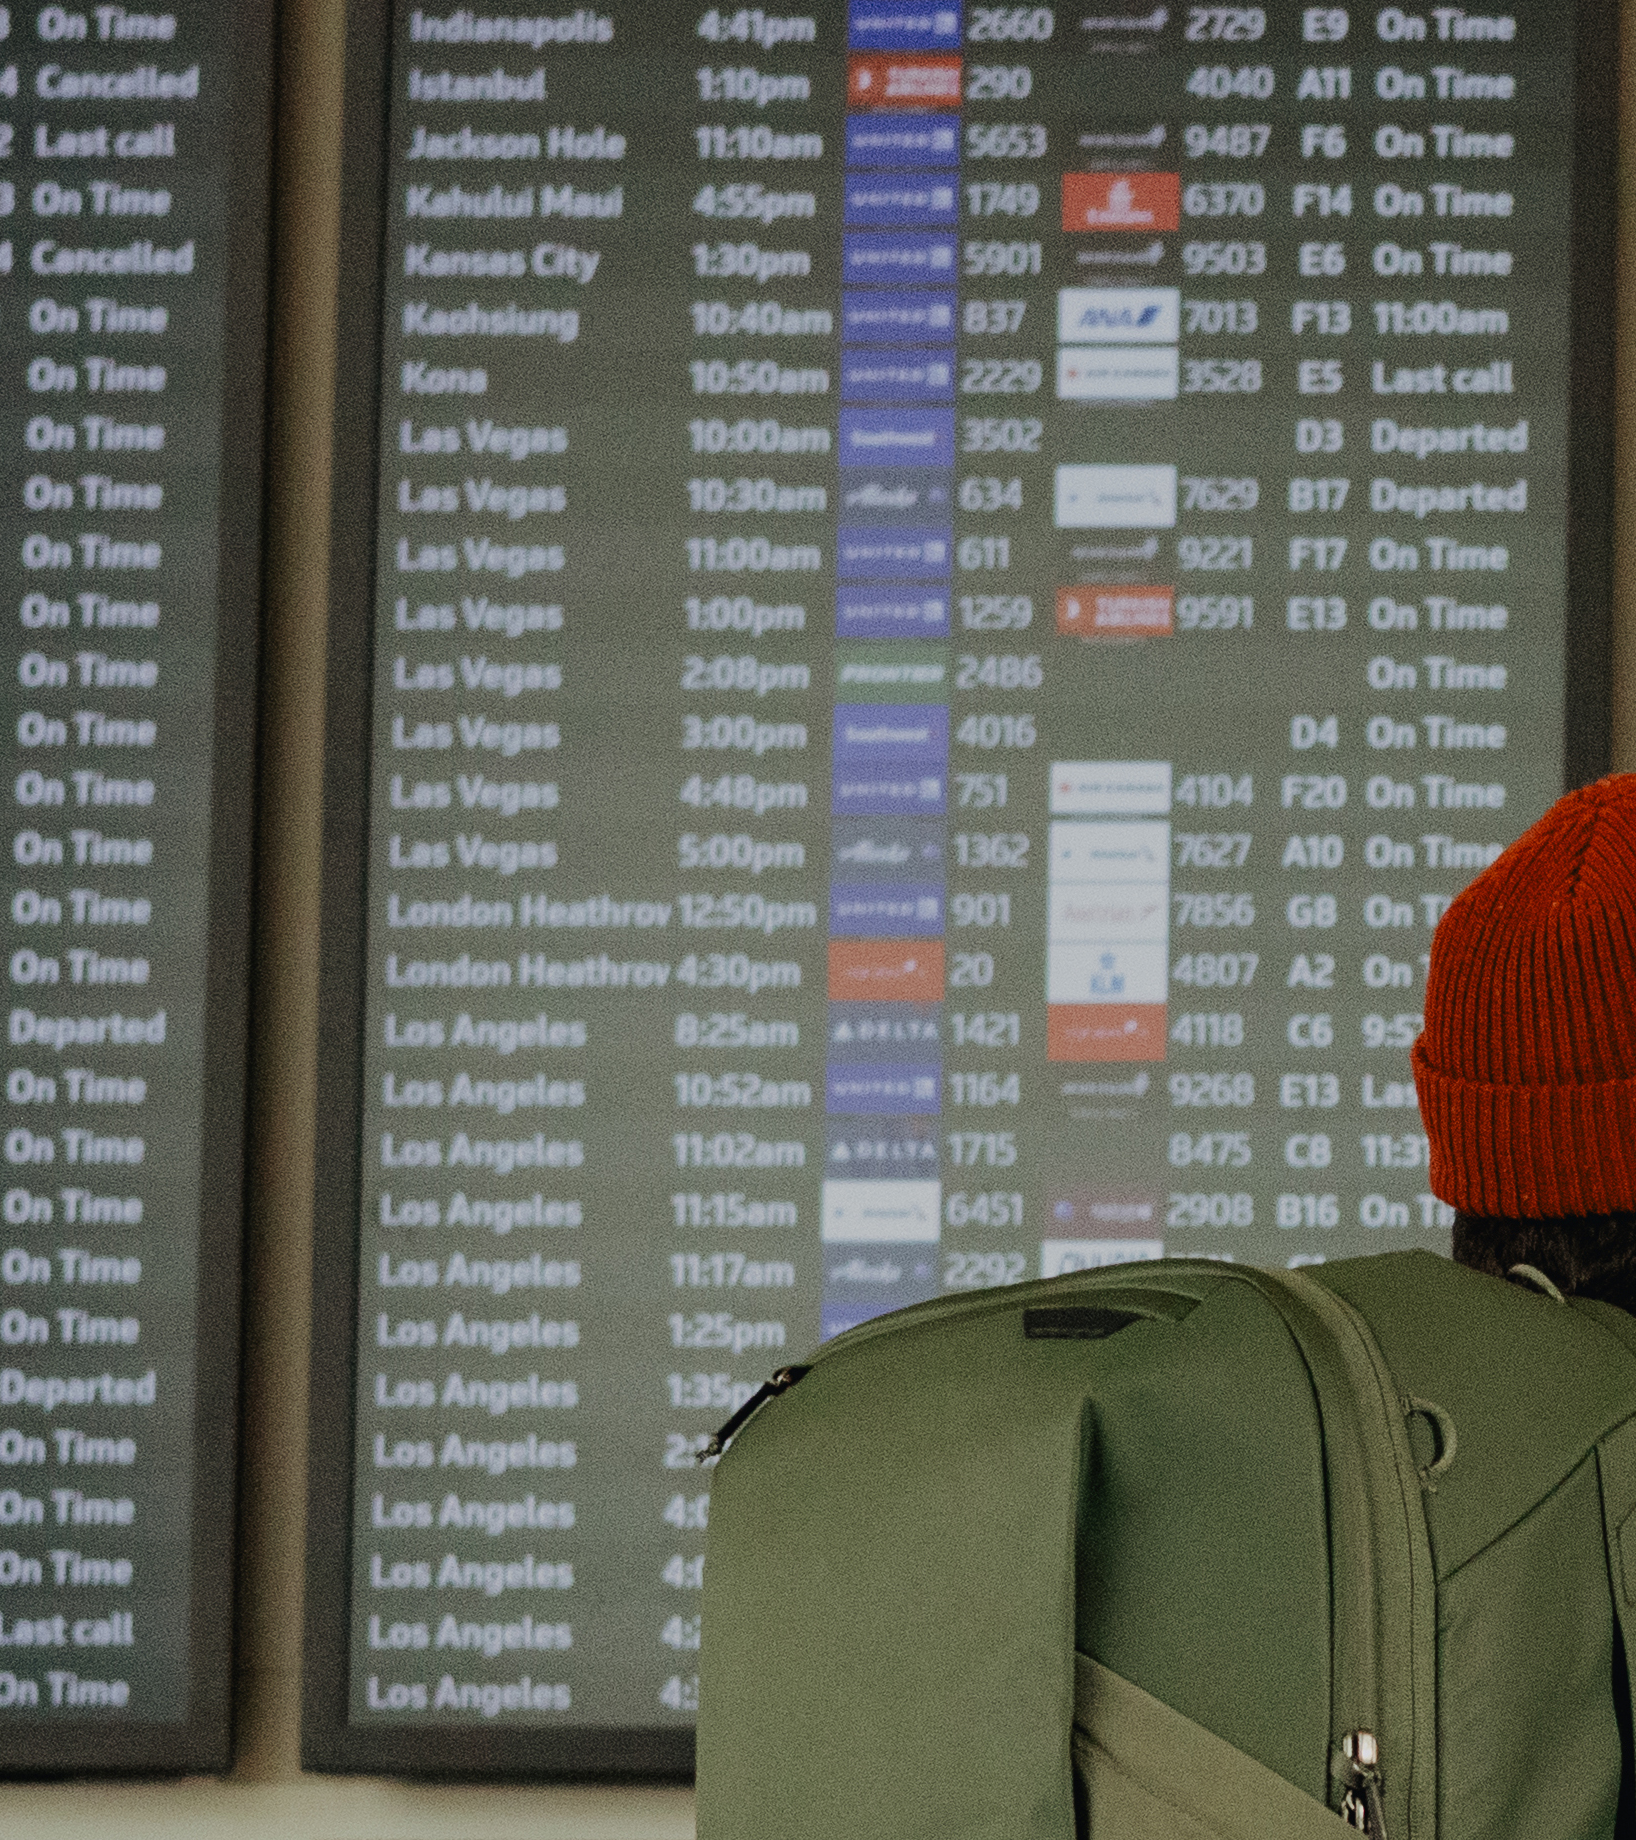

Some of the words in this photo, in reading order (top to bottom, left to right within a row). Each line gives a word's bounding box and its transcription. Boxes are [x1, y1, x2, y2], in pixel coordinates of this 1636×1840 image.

[36, 65, 199, 99] Cancelled
[409, 69, 546, 101] Istanbul
[697, 67, 810, 107] 1:10pm
[966, 66, 1032, 99] 290
[1187, 66, 1275, 99] 4040
[1297, 67, 1351, 99] A11
[1375, 67, 1426, 100] On
[1432, 66, 1515, 99] Time
[382, 1134, 443, 1167] Los
[448, 1133, 584, 1174] Angeles
[673, 1133, 806, 1167] 11:02am
[949, 1132, 1017, 1166] 1715
[1168, 1132, 1252, 1166] 8475
[72, 1612, 134, 1646] call
